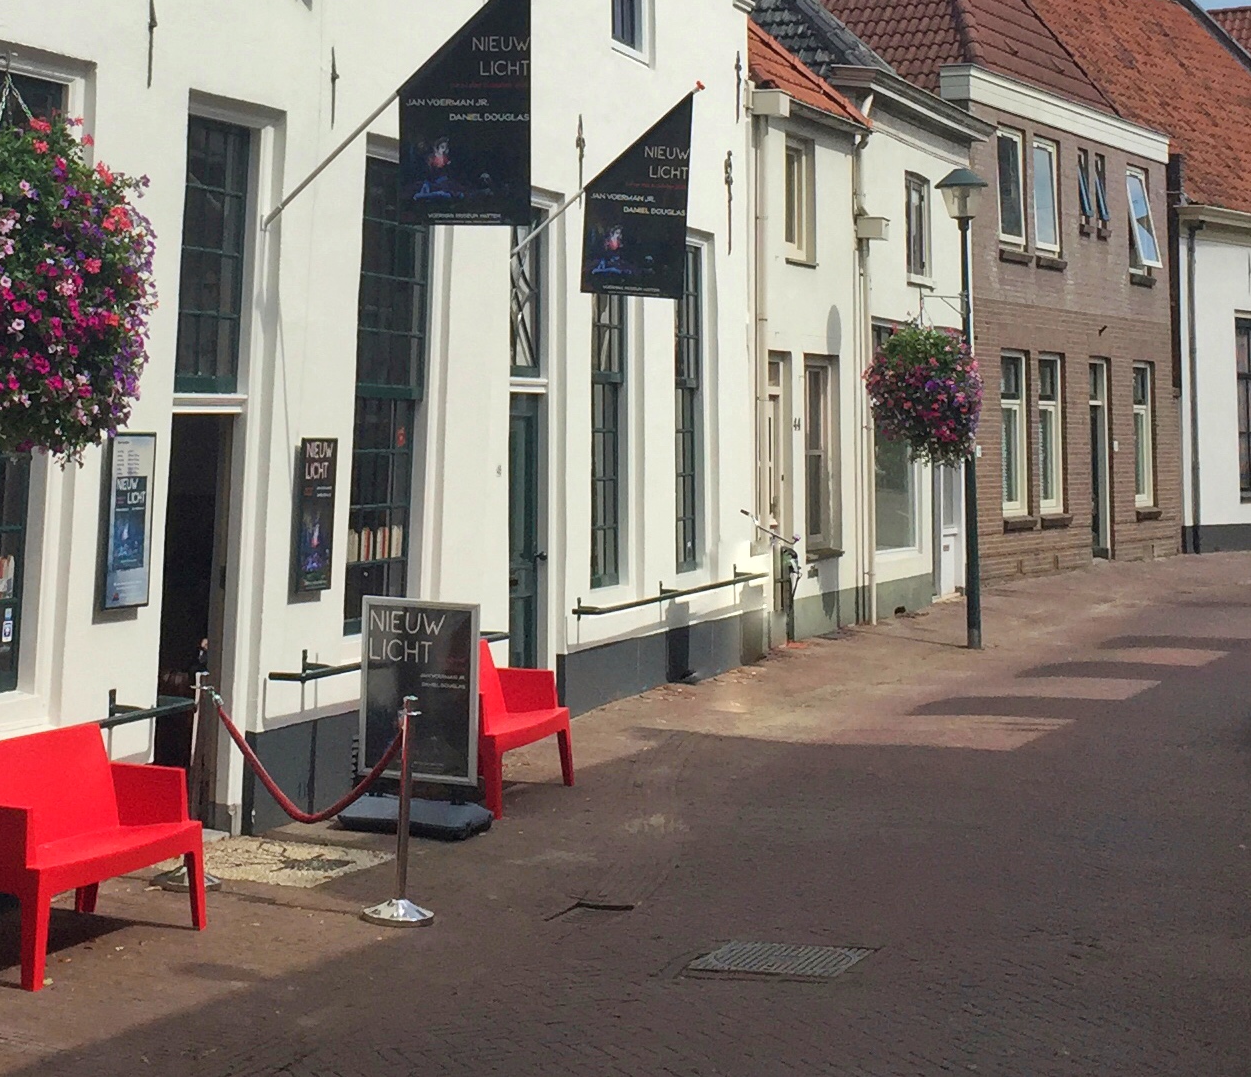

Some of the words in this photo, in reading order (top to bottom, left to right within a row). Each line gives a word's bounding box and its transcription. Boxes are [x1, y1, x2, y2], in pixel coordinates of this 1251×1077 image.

[471, 36, 530, 52] NIEUW
[480, 60, 530, 76] LICHT
[406, 98, 426, 107] JAN
[427, 98, 474, 107] VOERMAN
[449, 113, 483, 122] DANIEL
[484, 113, 530, 122] DOUGLAS
[644, 146, 690, 160] NIEUW
[649, 165, 688, 179] LICHT
[623, 206, 650, 215] DANIEL
[651, 207, 686, 217] DOUGLAS
[793, 417, 801, 431] 44
[306, 441, 334, 458] NIEUW
[305, 462, 329, 480] LICHT
[370, 609, 446, 636] NIEUW
[368, 638, 433, 664] LICHT
